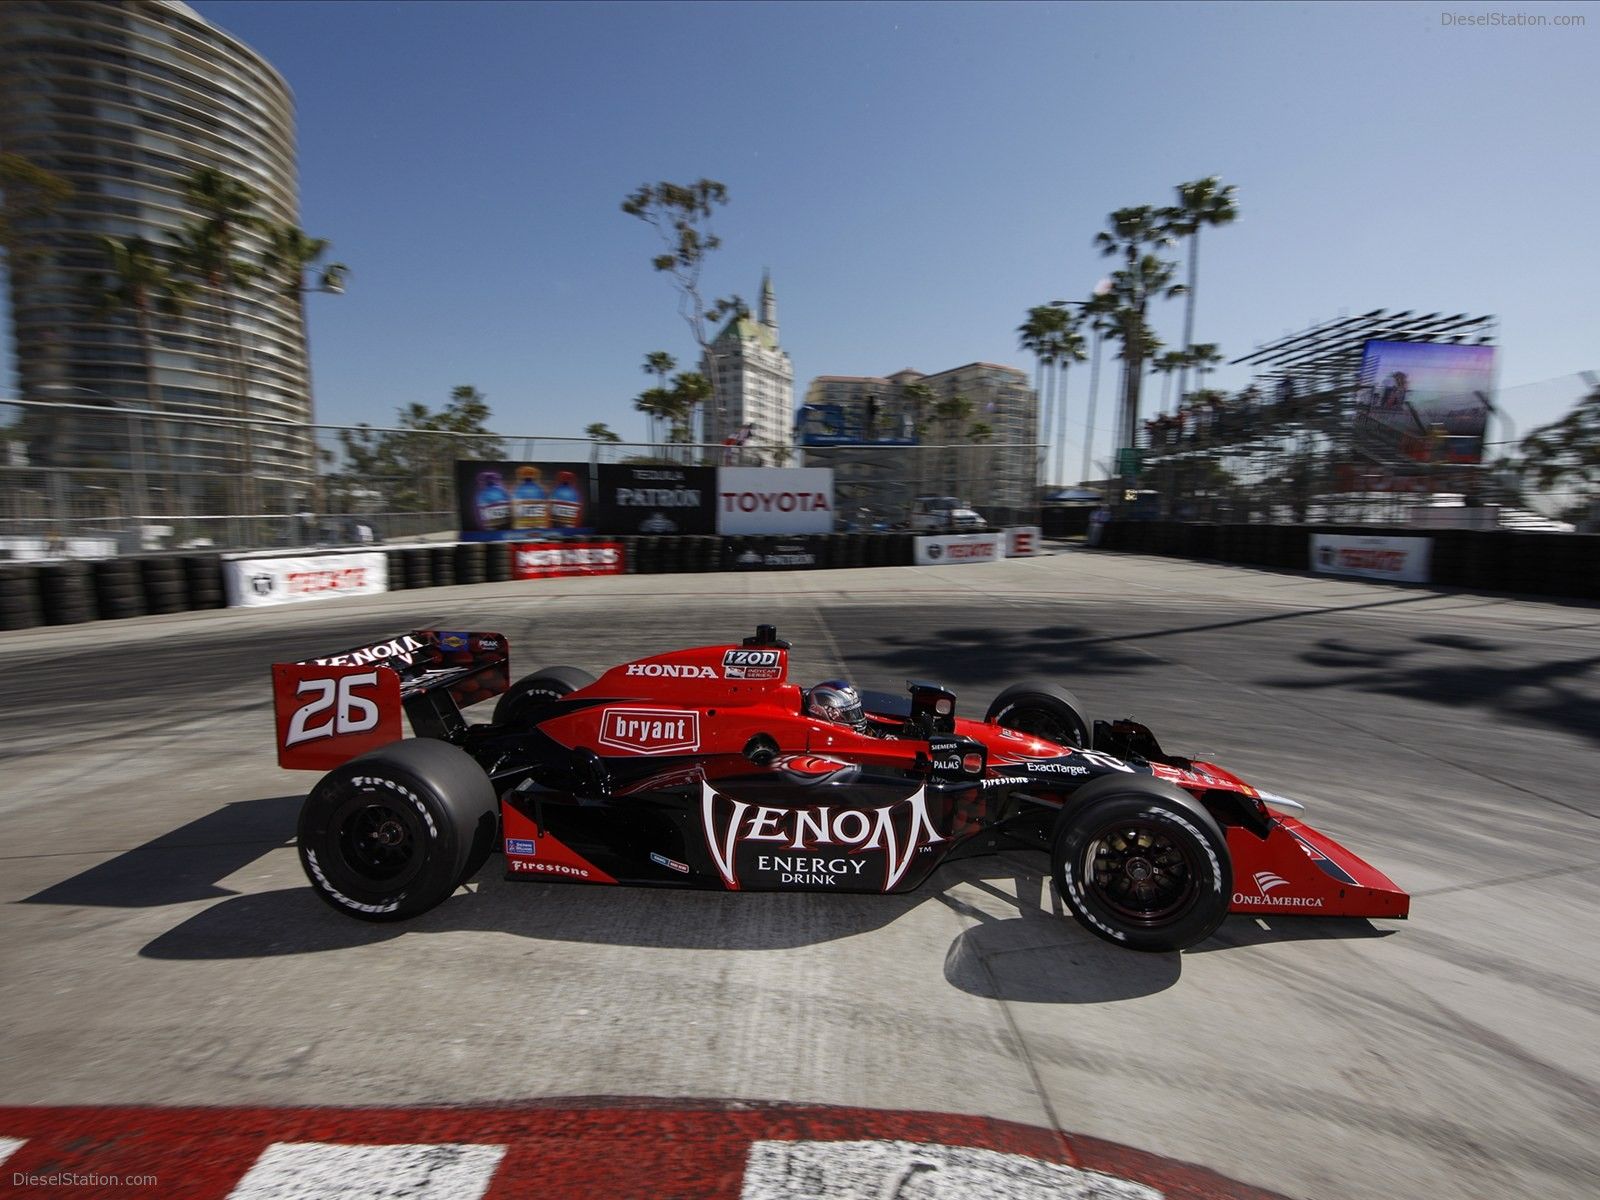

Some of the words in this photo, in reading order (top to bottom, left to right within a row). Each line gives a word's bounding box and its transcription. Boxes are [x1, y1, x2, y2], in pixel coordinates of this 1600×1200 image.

[720, 491, 831, 513] TOYOTA
[725, 651, 776, 665] IZOD
[626, 664, 719, 679] HONDA
[284, 670, 380, 748] 26
[616, 716, 685, 742] bryant
[933, 760, 960, 769] PALMS
[1027, 762, 1089, 776] ExactTarget
[980, 777, 1029, 789] Firestone
[702, 780, 945, 892] VENOM
[511, 860, 590, 877] Firestone
[758, 856, 867, 875] ENERGY
[781, 873, 836, 885] DRINK
